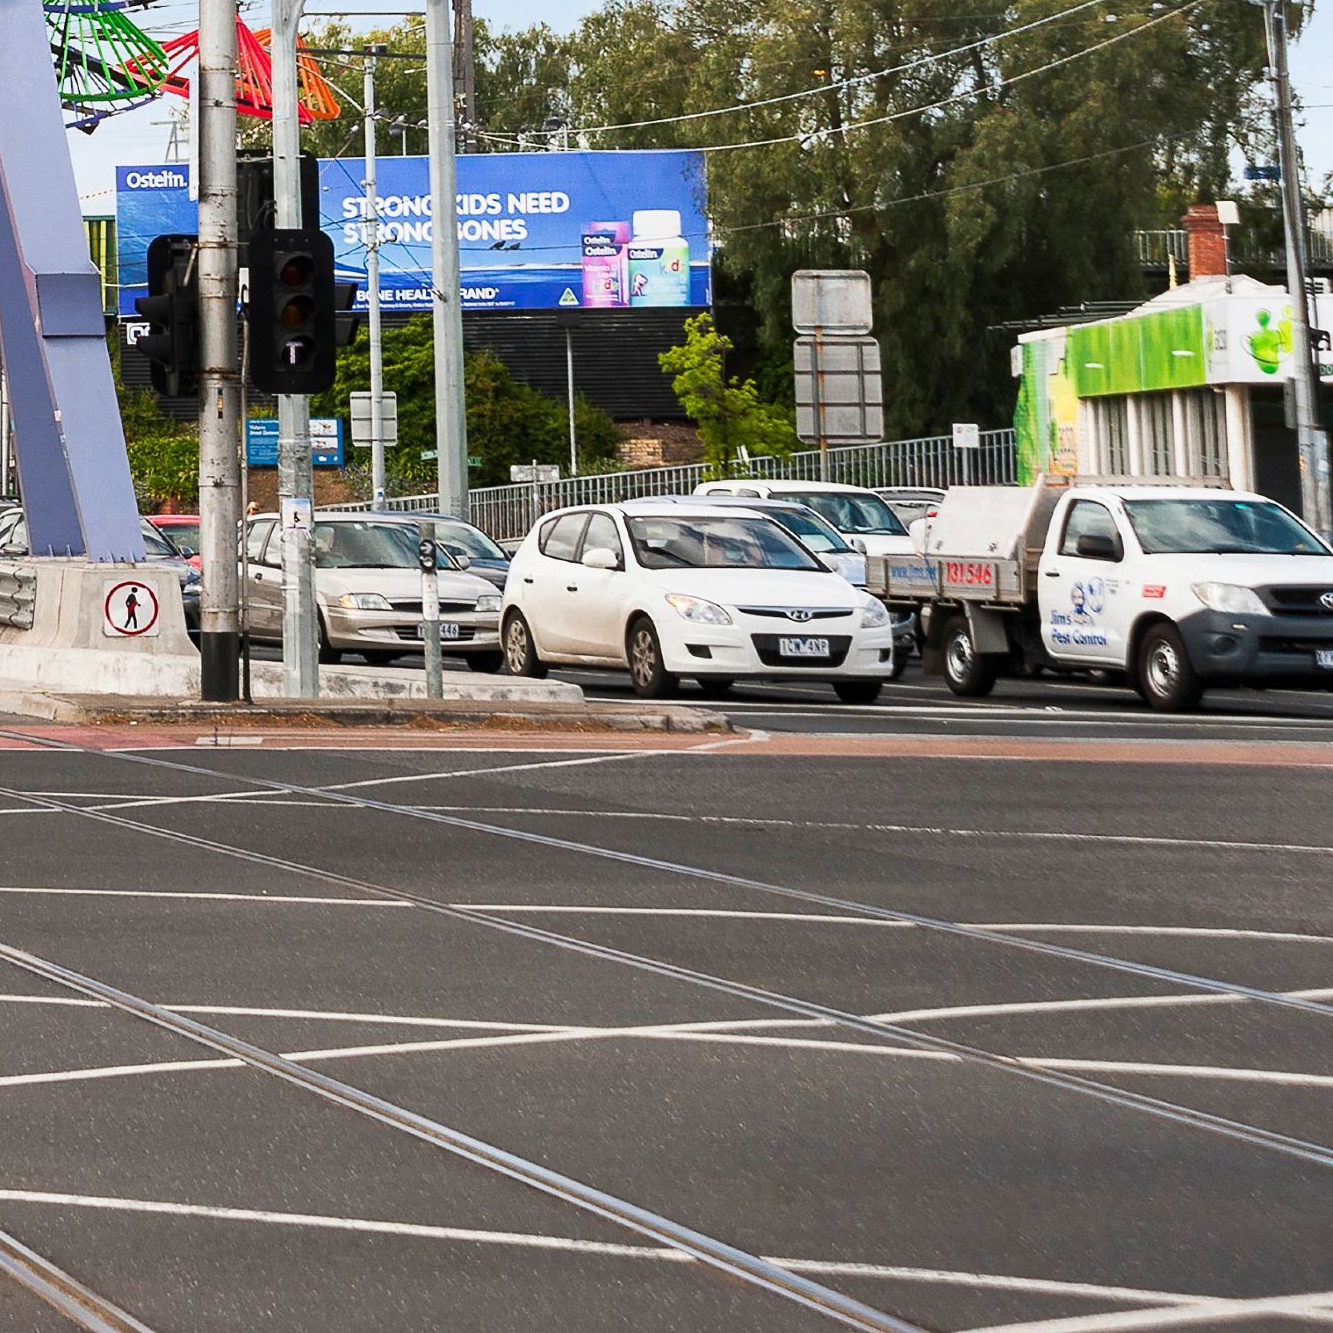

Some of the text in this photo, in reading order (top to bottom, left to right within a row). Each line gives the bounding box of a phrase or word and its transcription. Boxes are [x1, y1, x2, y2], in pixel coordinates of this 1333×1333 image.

[507, 191, 570, 214] NEED
[395, 288, 434, 301] HEALT
[1051, 629, 1107, 646] Pest Control
